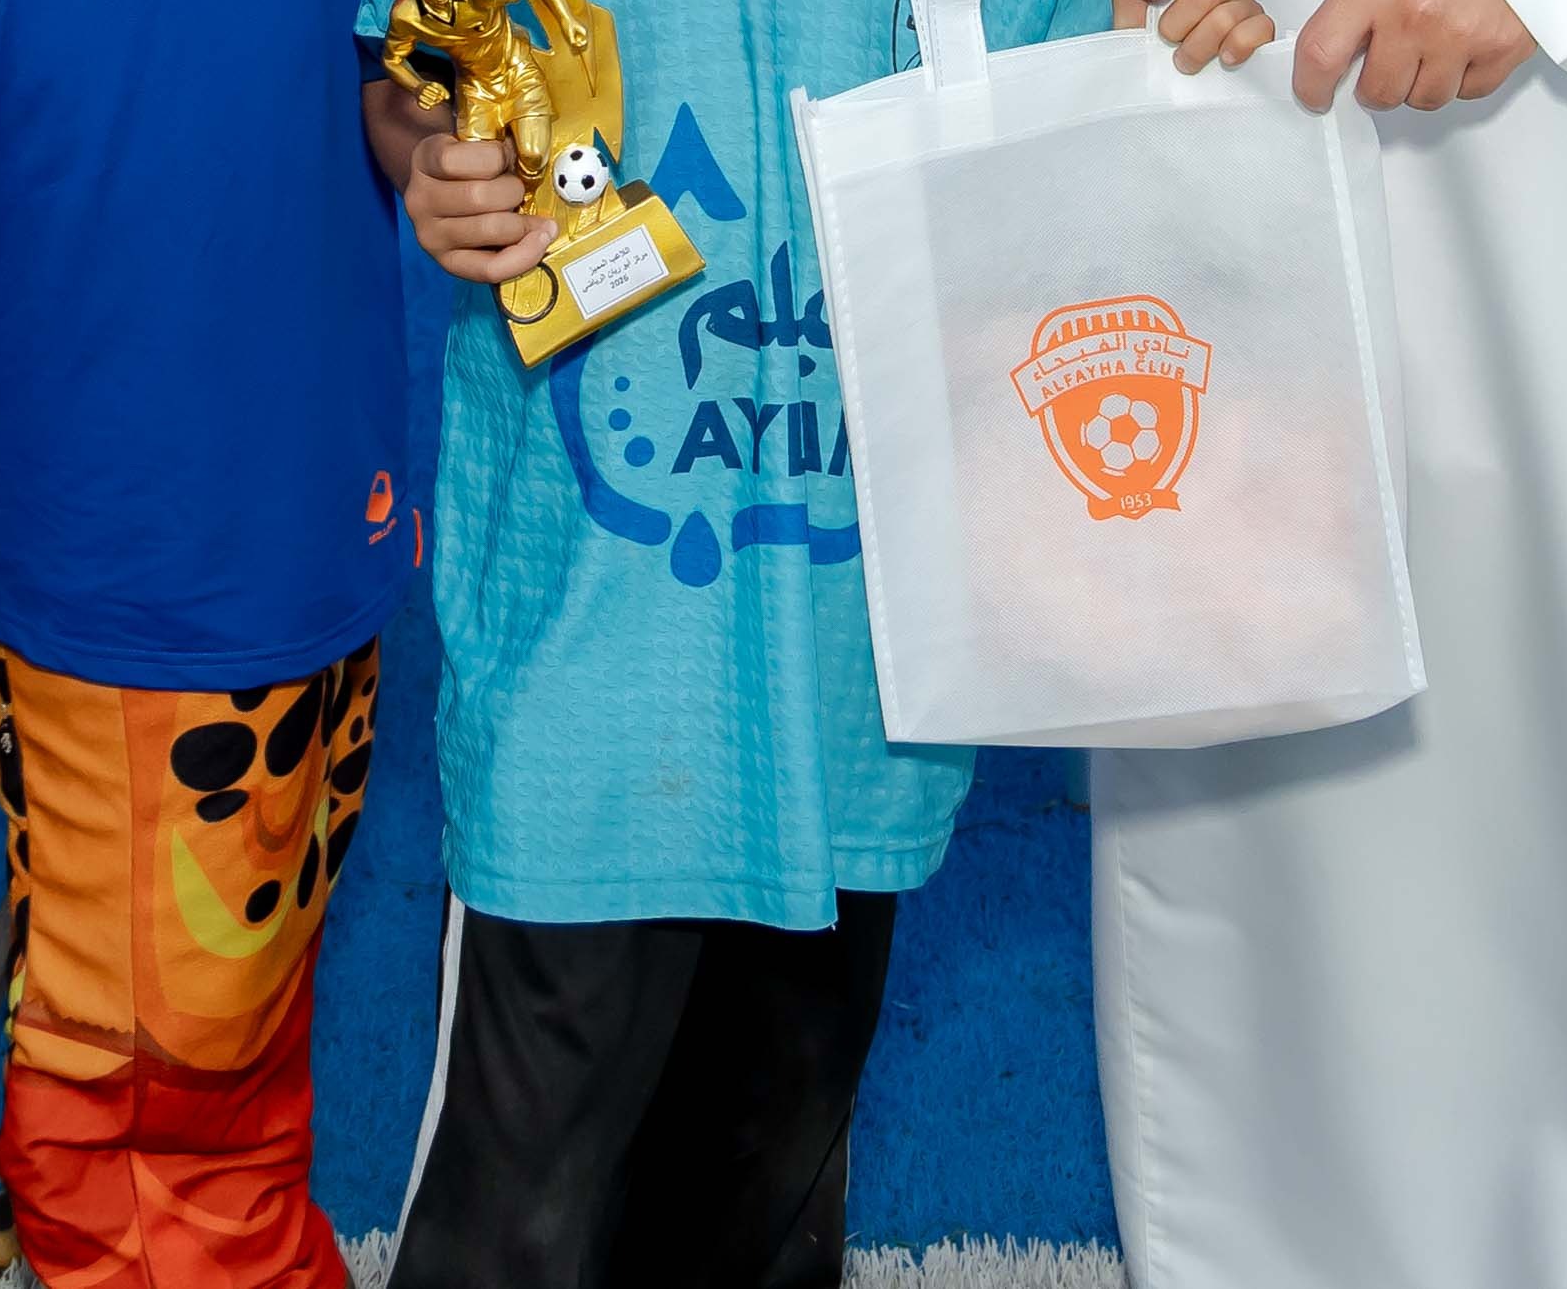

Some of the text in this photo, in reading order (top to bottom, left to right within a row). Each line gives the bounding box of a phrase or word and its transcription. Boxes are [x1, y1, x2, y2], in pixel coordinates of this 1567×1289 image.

[1033, 332, 1191, 381] نادي الفيحاء
[1041, 359, 1186, 400] ALFAYHA CLUB
[1120, 491, 1153, 511] 1953
